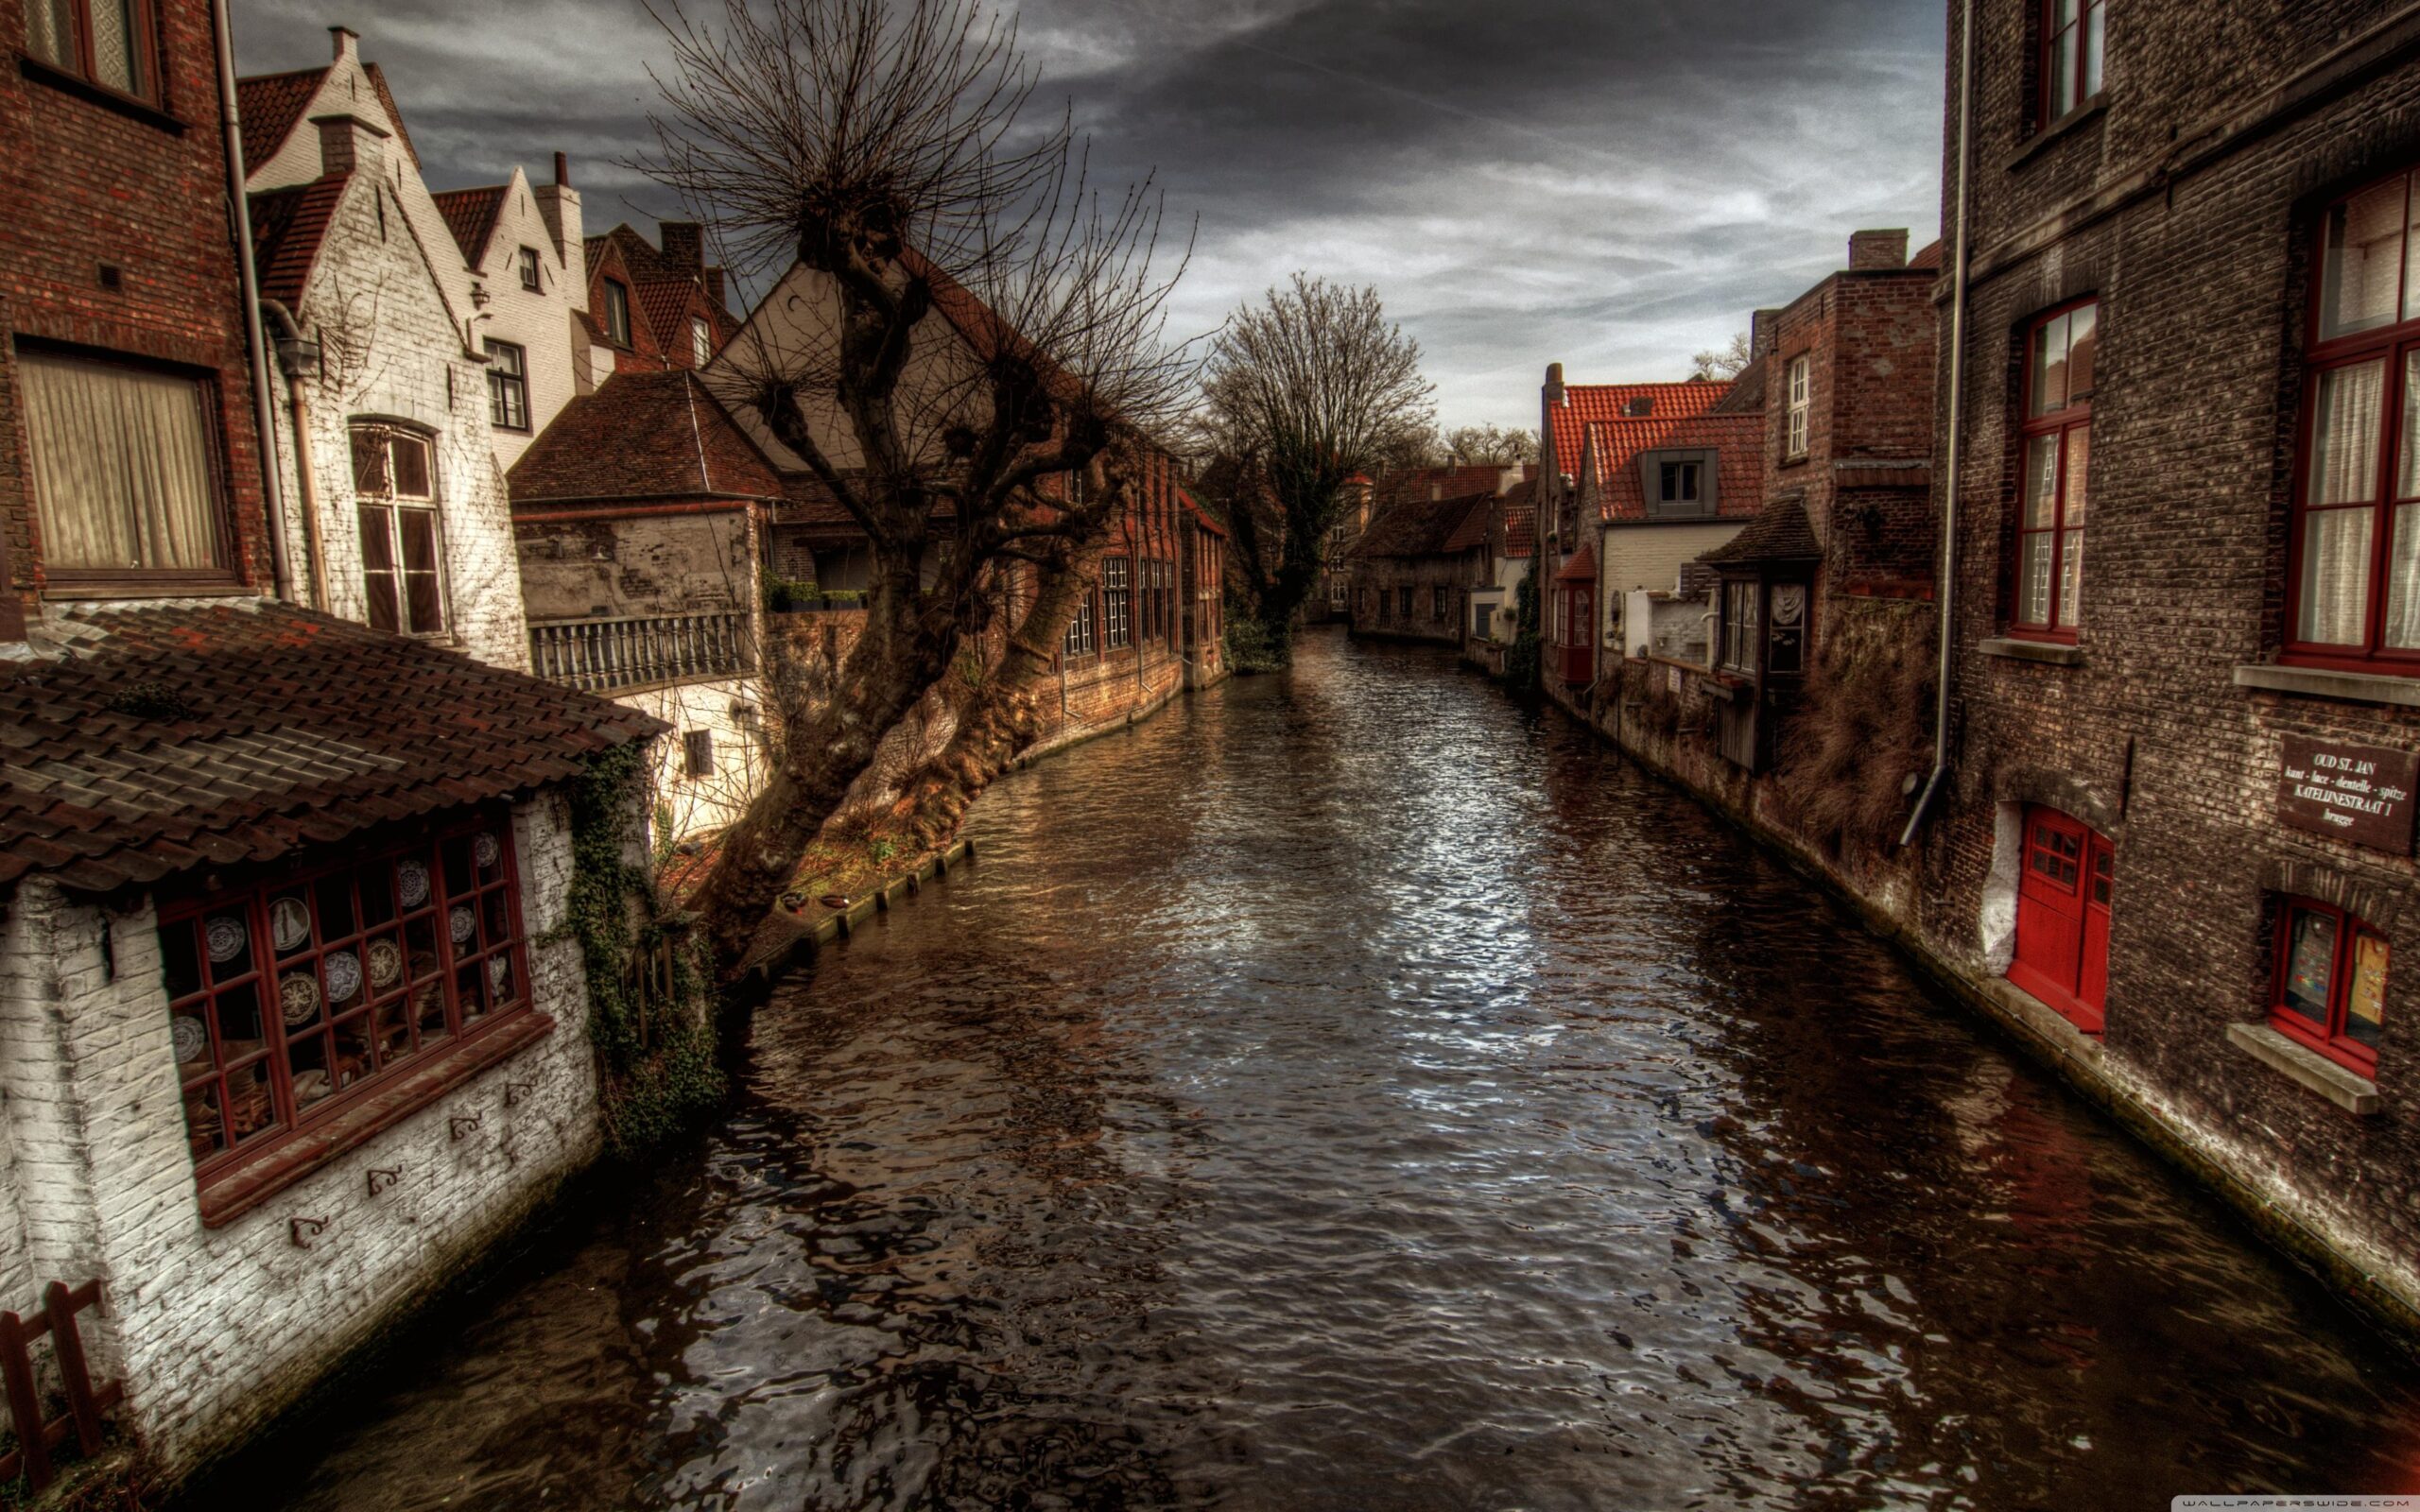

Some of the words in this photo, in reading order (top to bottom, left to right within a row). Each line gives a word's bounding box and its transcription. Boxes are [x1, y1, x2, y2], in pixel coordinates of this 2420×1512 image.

[2314, 753, 2337, 768] OUD
[2338, 758, 2353, 771] ST.
[2355, 761, 2377, 775] JAN
[2310, 770, 2329, 784] lace
[2336, 776, 2372, 793] dentelle
[2378, 785, 2407, 800] spitze
[2324, 808, 2355, 827] brugge
